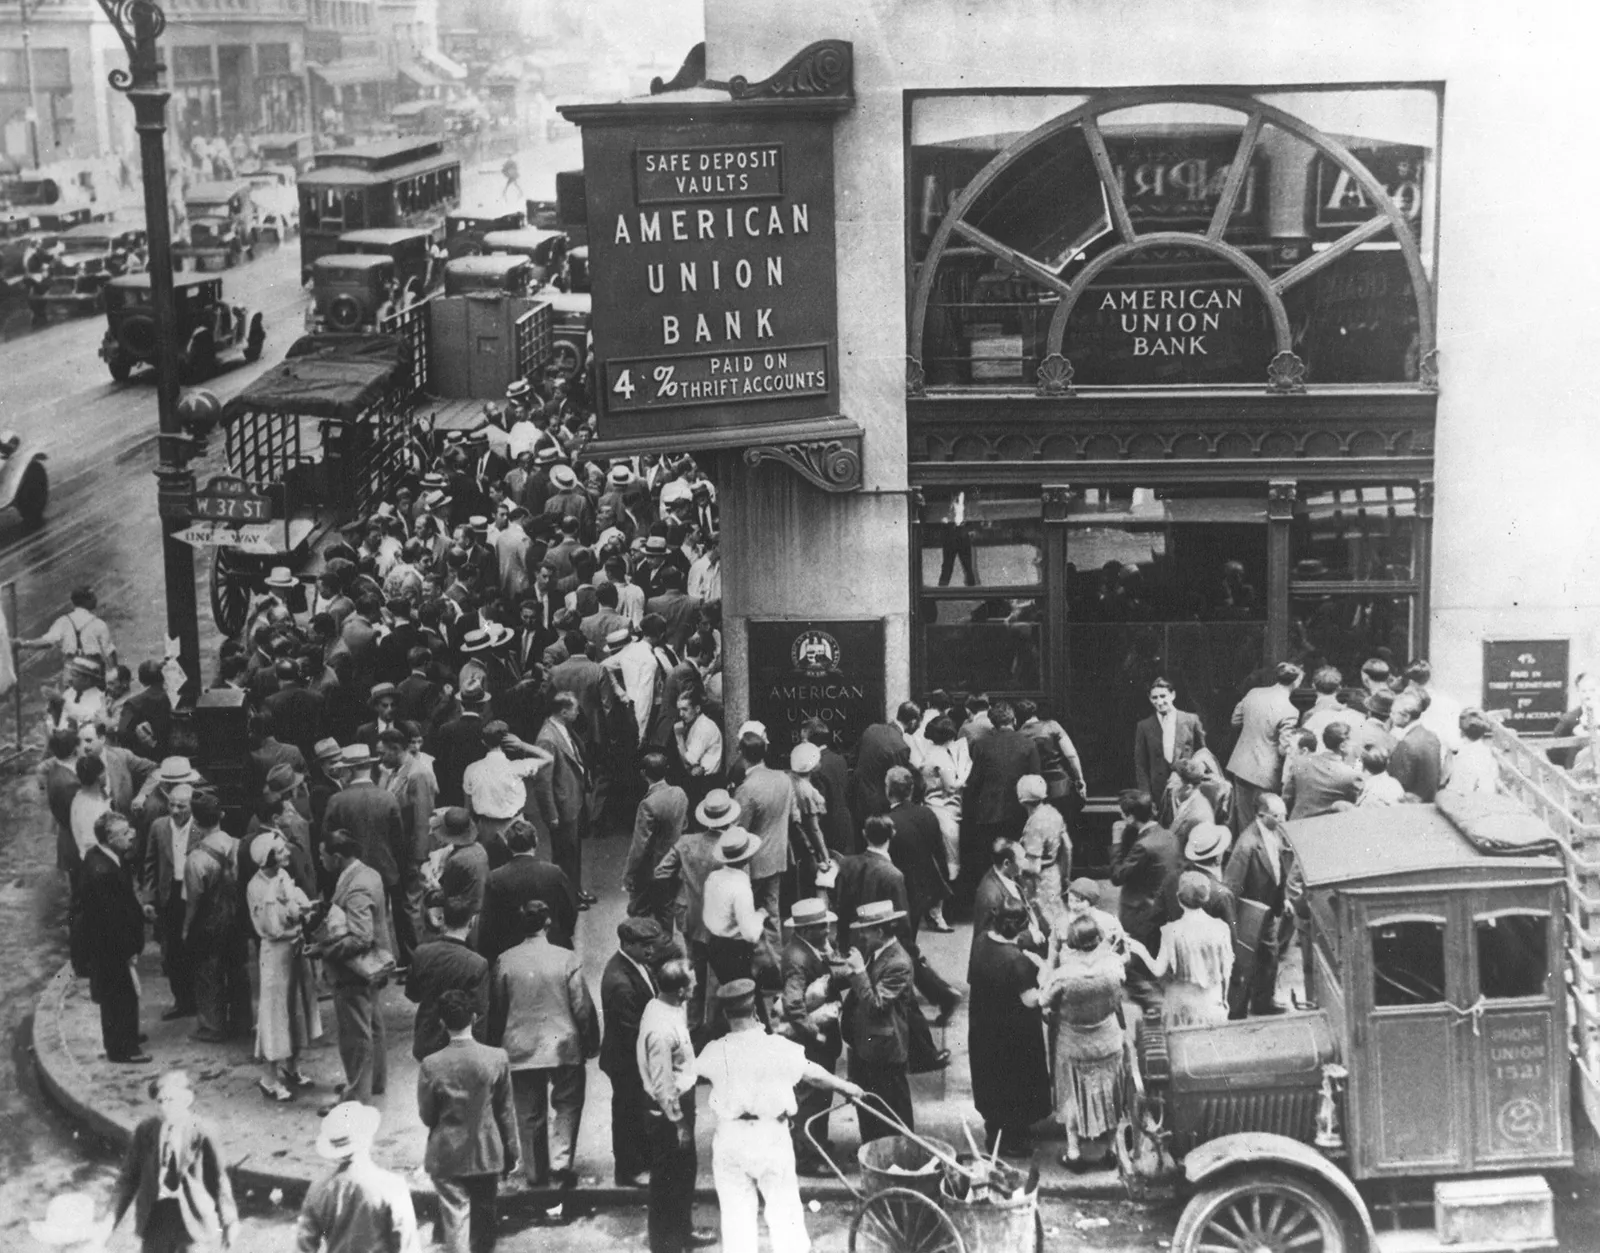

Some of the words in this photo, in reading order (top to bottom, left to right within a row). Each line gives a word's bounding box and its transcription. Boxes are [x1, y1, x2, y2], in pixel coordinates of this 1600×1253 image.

[646, 154, 691, 172] SAFE
[700, 150, 778, 170] DEPOSIT
[676, 174, 749, 194] VAULTS
[615, 204, 810, 245] AMERICAN
[648, 257, 783, 293] UNION
[1099, 288, 1242, 310] AMERICAN
[663, 308, 774, 345] BANK
[1121, 312, 1219, 333] UNION
[1133, 335, 1208, 356] BANK
[710, 355, 753, 374] PAID
[764, 353, 787, 370] ON
[680, 378, 739, 398] THRIFT
[743, 371, 825, 394] ACCOUNTS
[216, 498, 236, 517] 37
[769, 685, 864, 699] AMERICAN
[791, 729, 843, 744] BK
[1490, 1045, 1545, 1060] UNION
